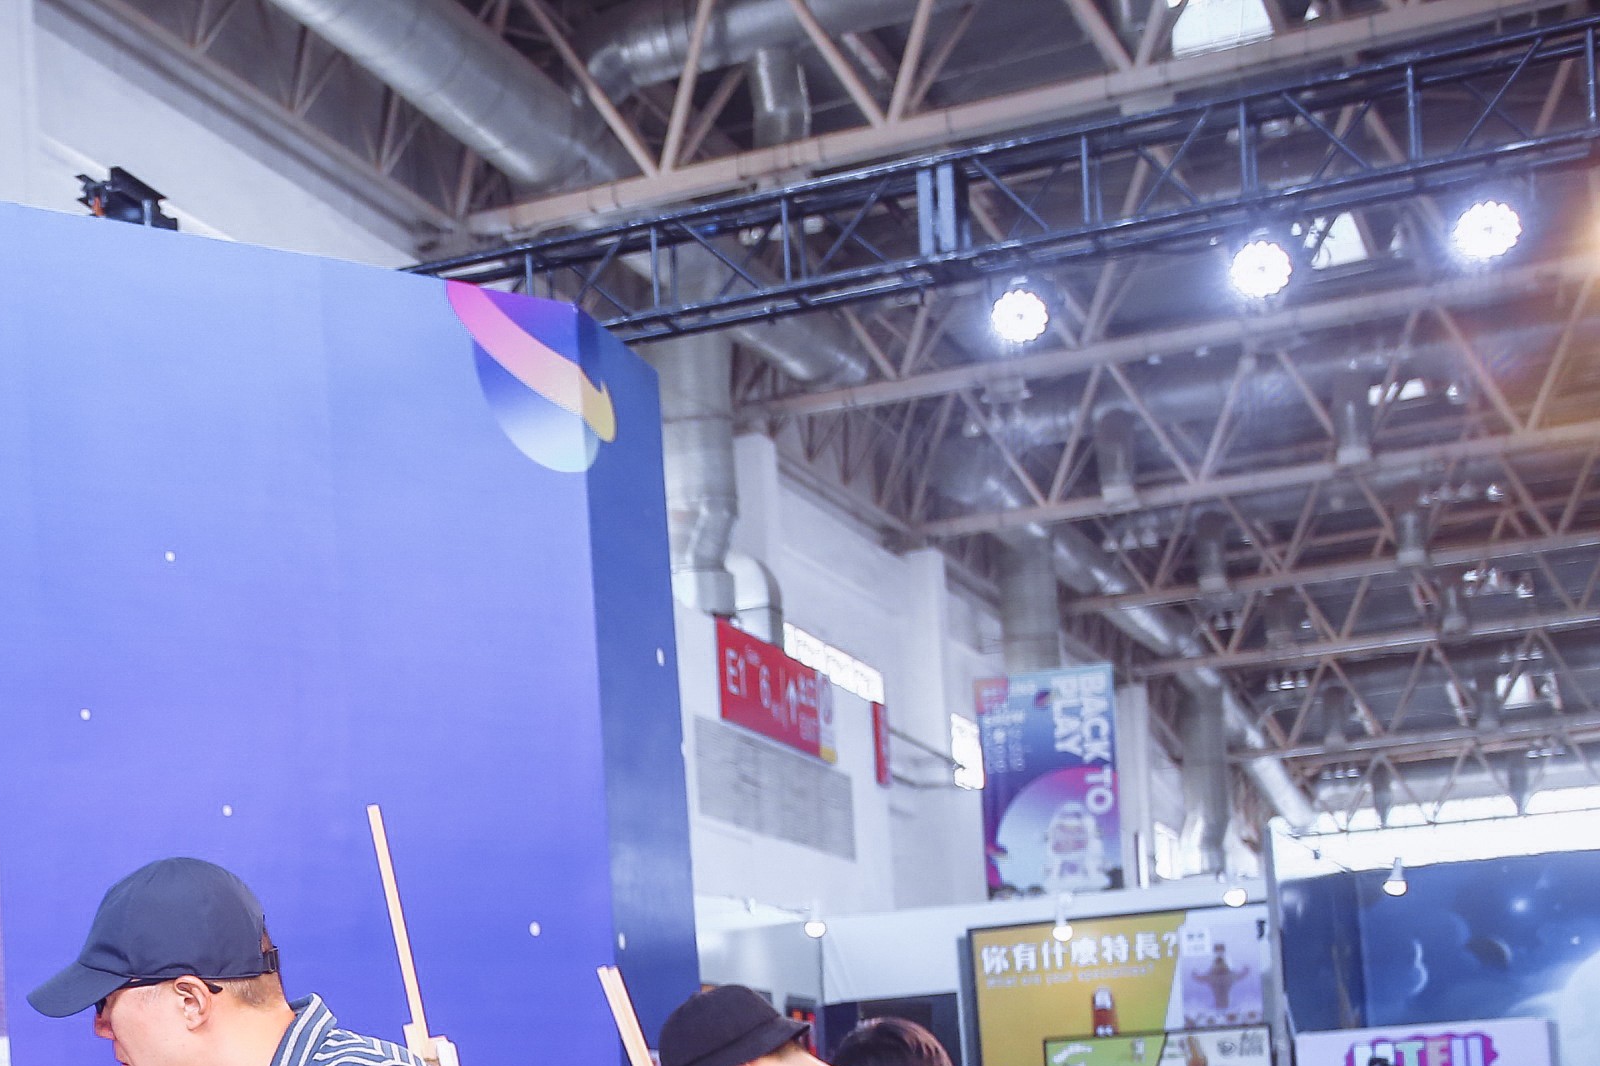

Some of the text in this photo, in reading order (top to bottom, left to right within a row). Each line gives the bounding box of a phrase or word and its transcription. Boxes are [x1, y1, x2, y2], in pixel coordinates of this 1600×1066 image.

[1051, 676, 1084, 758] PLAY
[1080, 672, 1113, 815] BACK TO
